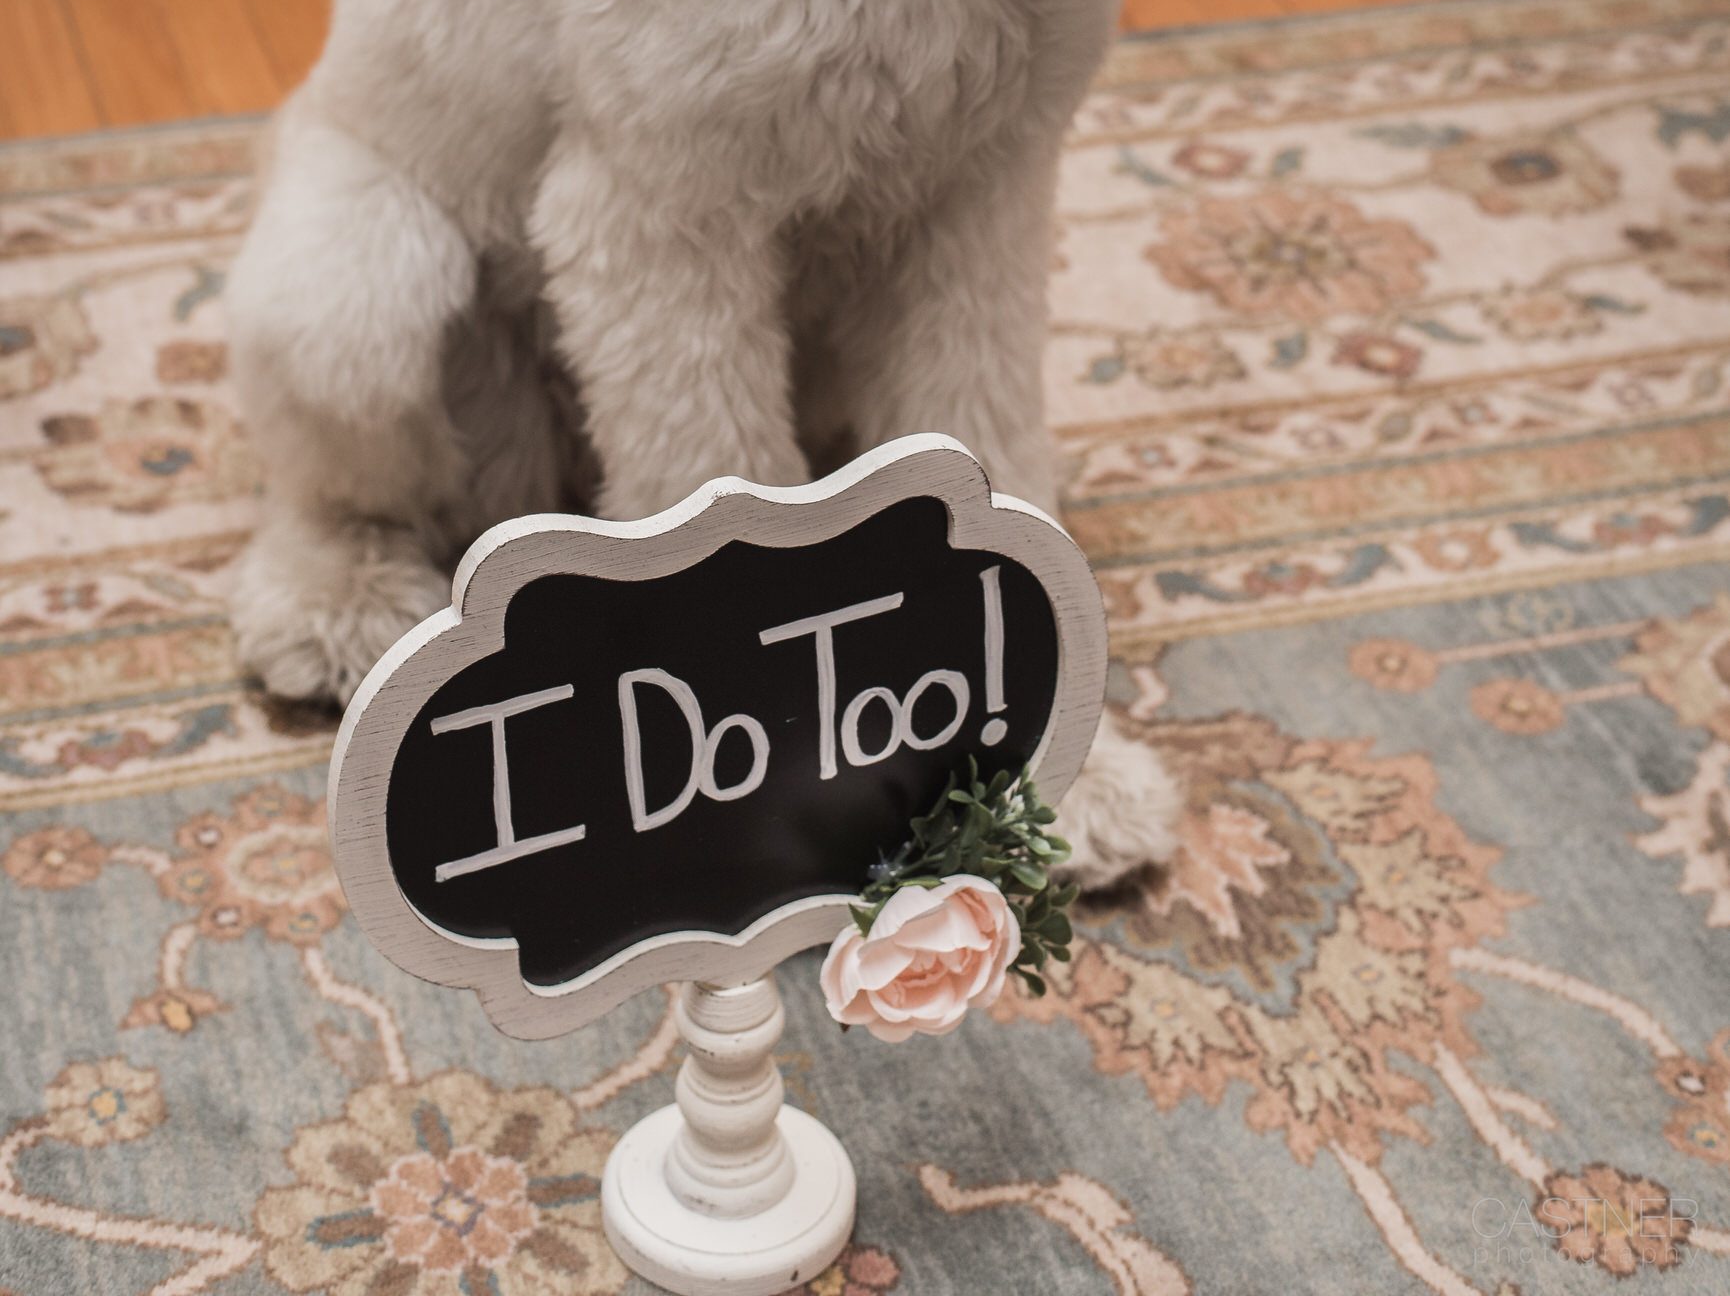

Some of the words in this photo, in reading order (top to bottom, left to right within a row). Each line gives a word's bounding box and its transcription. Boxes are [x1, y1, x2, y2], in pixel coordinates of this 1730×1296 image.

[430, 683, 586, 883] I
[618, 667, 770, 833] Do
[758, 565, 1008, 781] Too!
